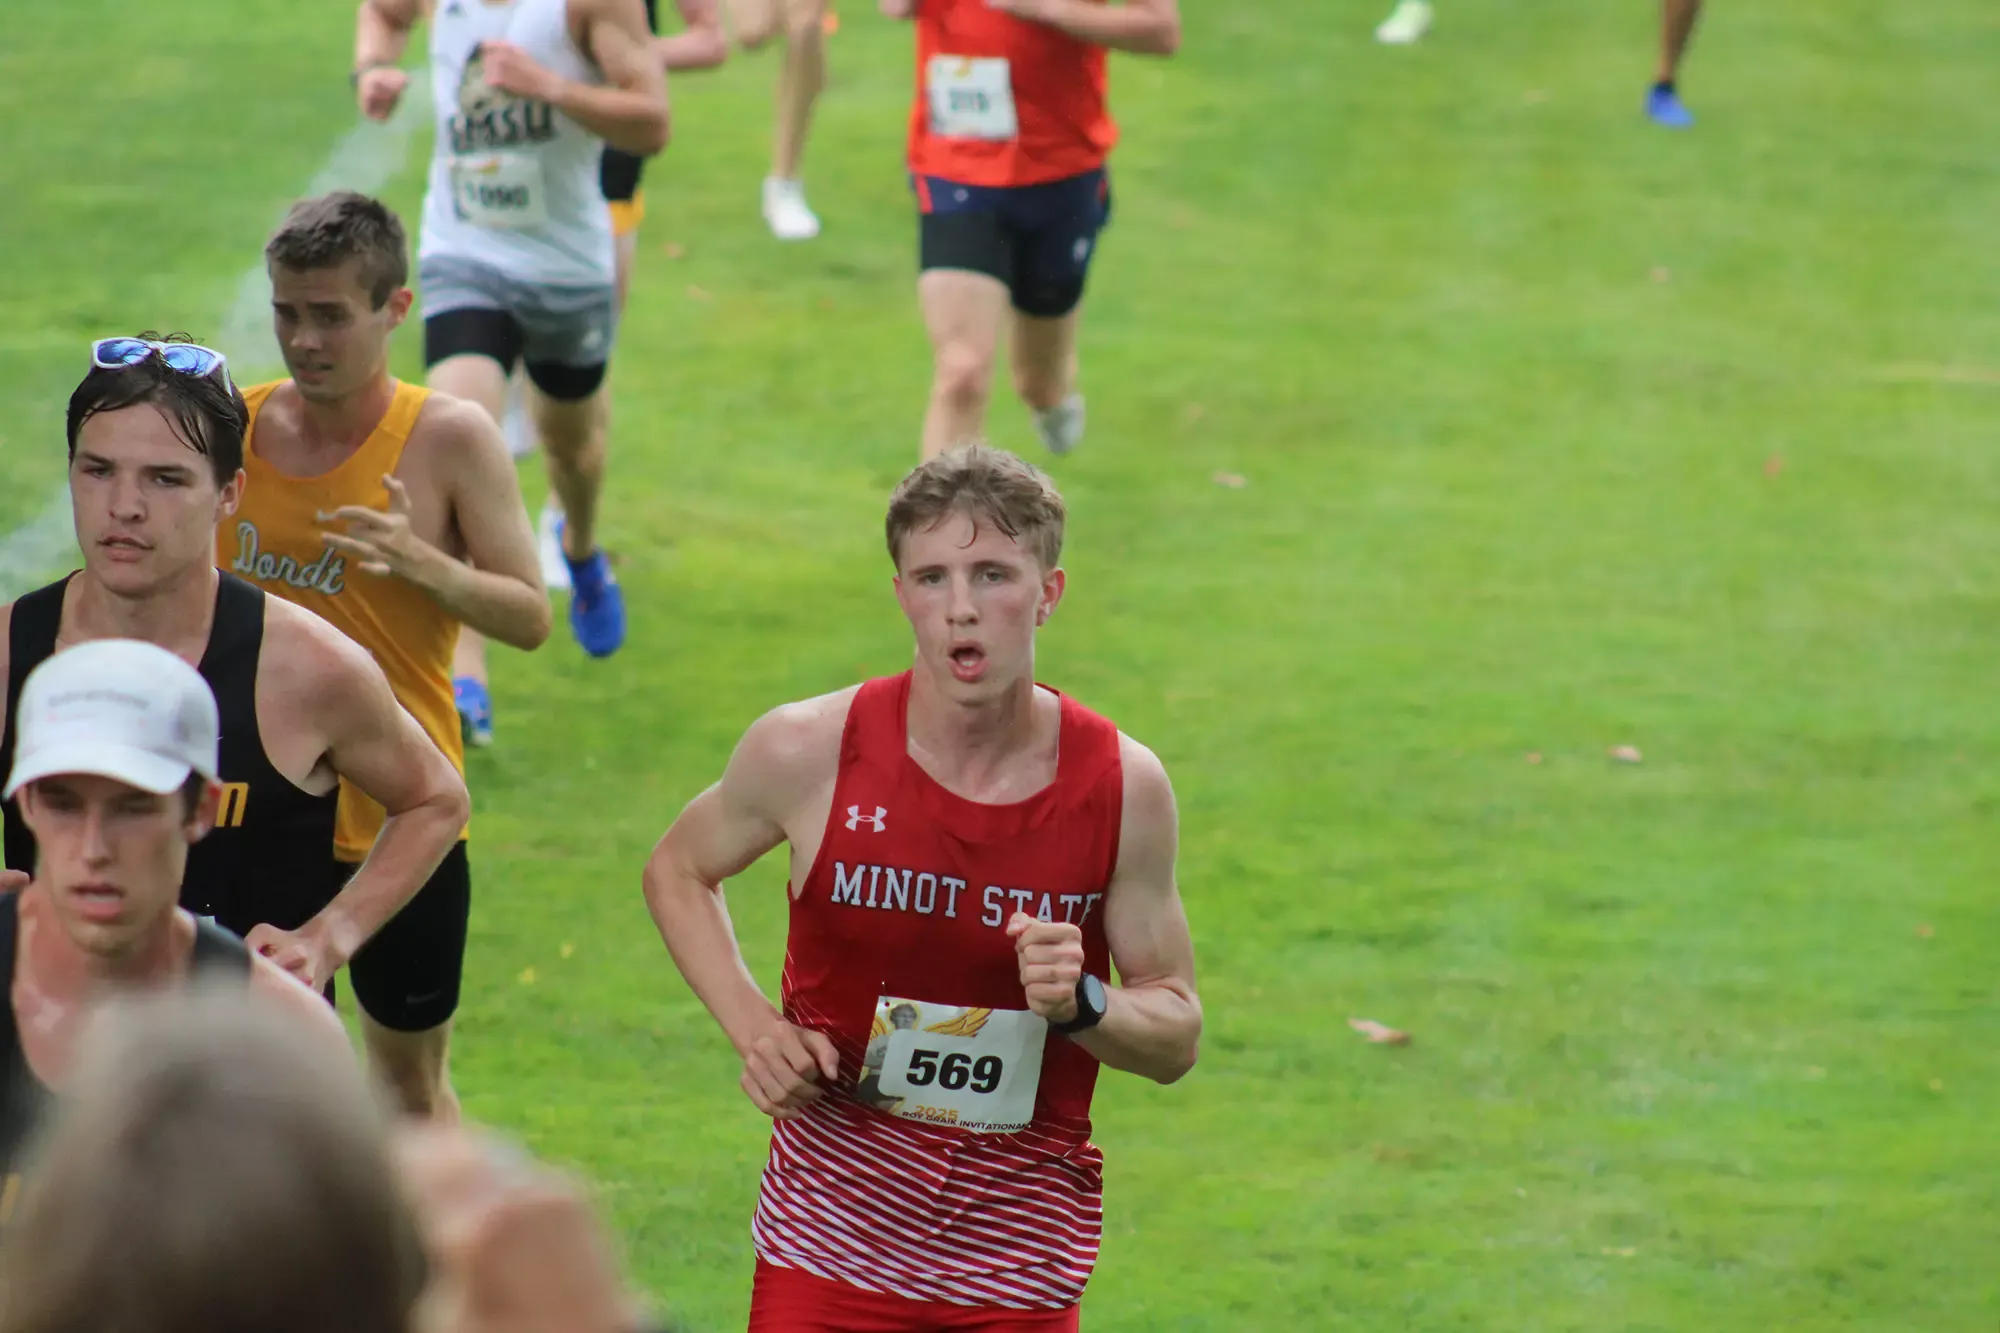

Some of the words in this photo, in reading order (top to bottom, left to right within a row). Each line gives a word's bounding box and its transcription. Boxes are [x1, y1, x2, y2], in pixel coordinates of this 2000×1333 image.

[232, 521, 345, 595] Dordt
[831, 861, 967, 918] MINOT
[906, 1048, 1003, 1094] 569
[902, 1111, 923, 1119] ROY
[915, 1105, 960, 1120] 2025
